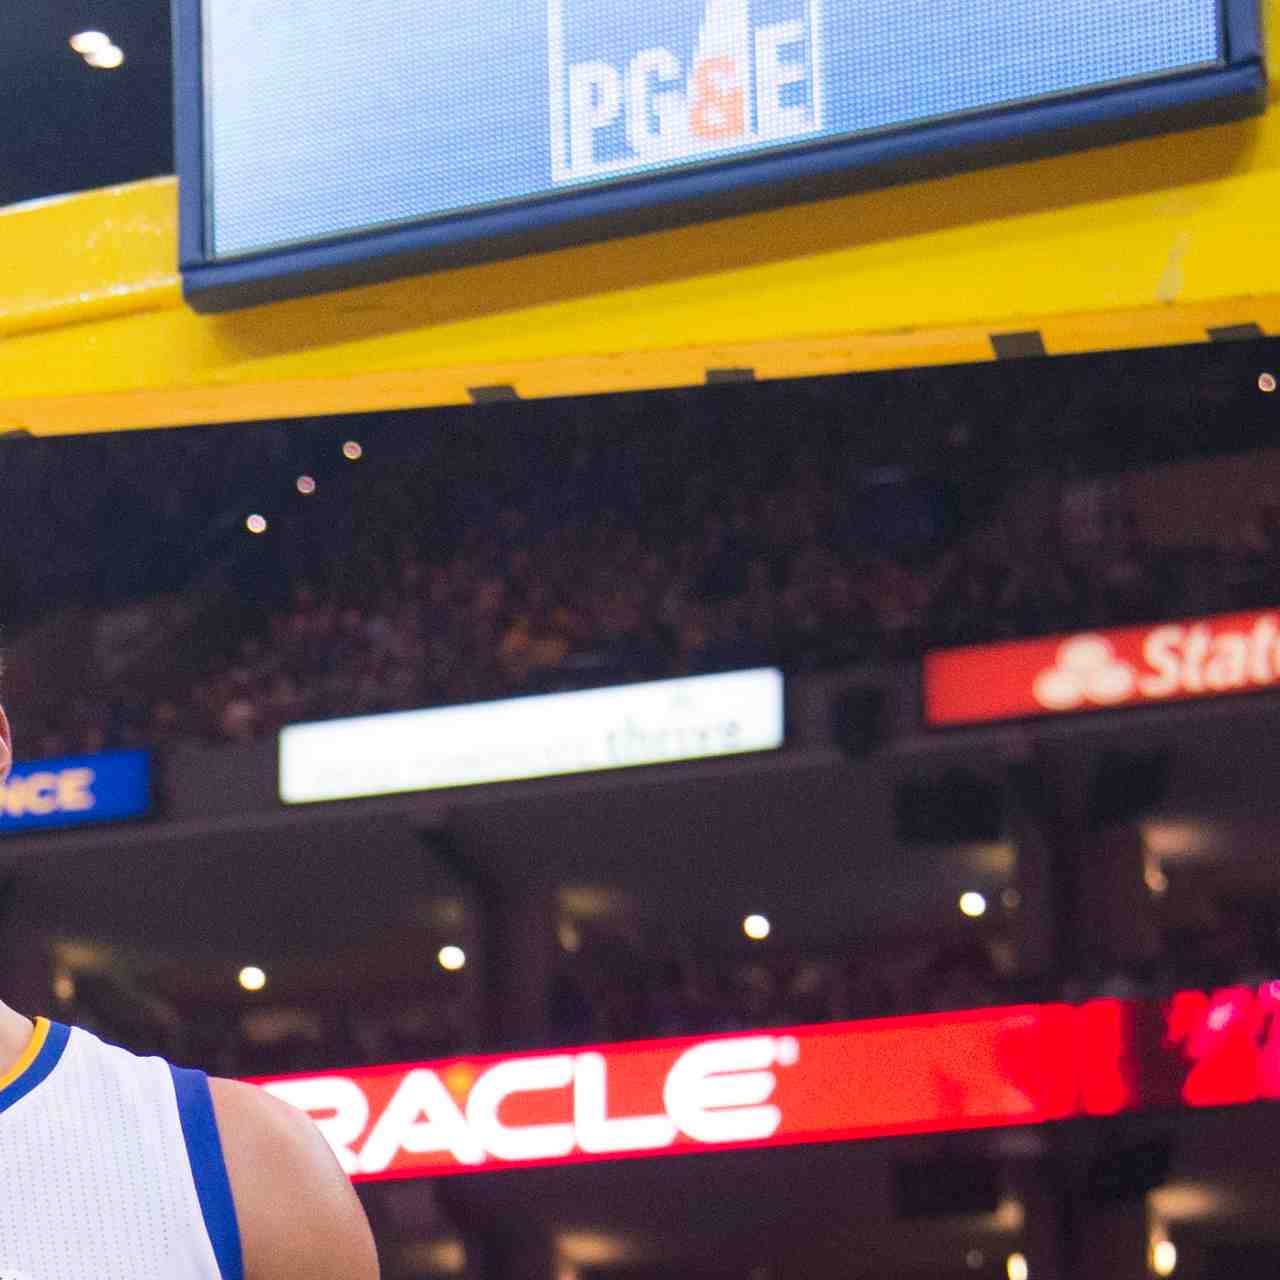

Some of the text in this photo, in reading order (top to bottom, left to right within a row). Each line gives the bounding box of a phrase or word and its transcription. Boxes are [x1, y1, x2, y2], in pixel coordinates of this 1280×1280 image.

[569, 20, 808, 166] PG&E
[1139, 614, 1280, 699] Stat
[258, 1035, 783, 1175] RACLE
